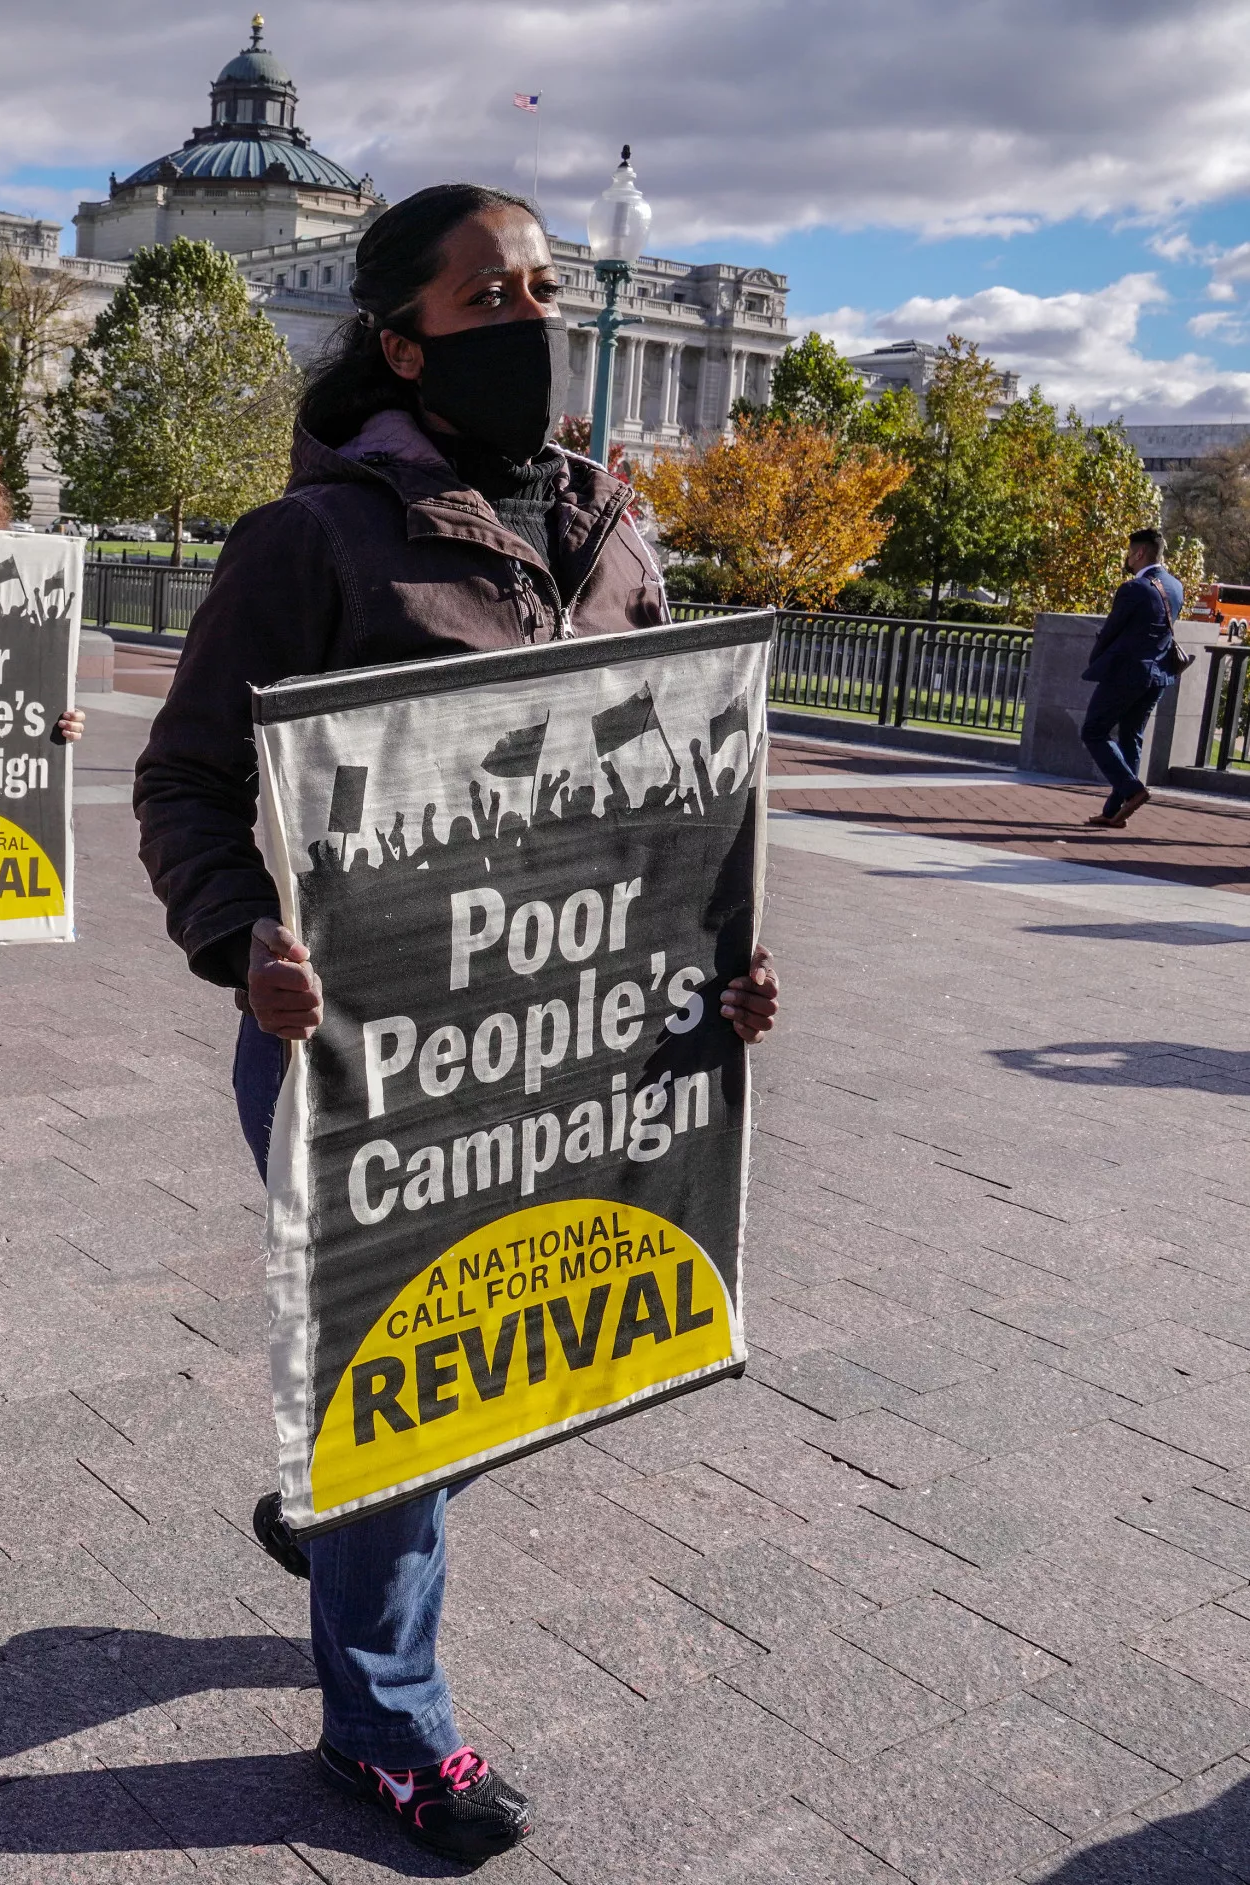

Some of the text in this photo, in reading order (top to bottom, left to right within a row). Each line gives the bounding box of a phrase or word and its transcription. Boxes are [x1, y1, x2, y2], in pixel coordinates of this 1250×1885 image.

[450, 876, 642, 991] Poor
[363, 950, 706, 1120] People's
[348, 1070, 710, 1225] Campaign
[386, 1229, 676, 1339] CALL FOR MORAL
[426, 1211, 630, 1296] A NATIONAL
[351, 1258, 714, 1447] REVIVAL
